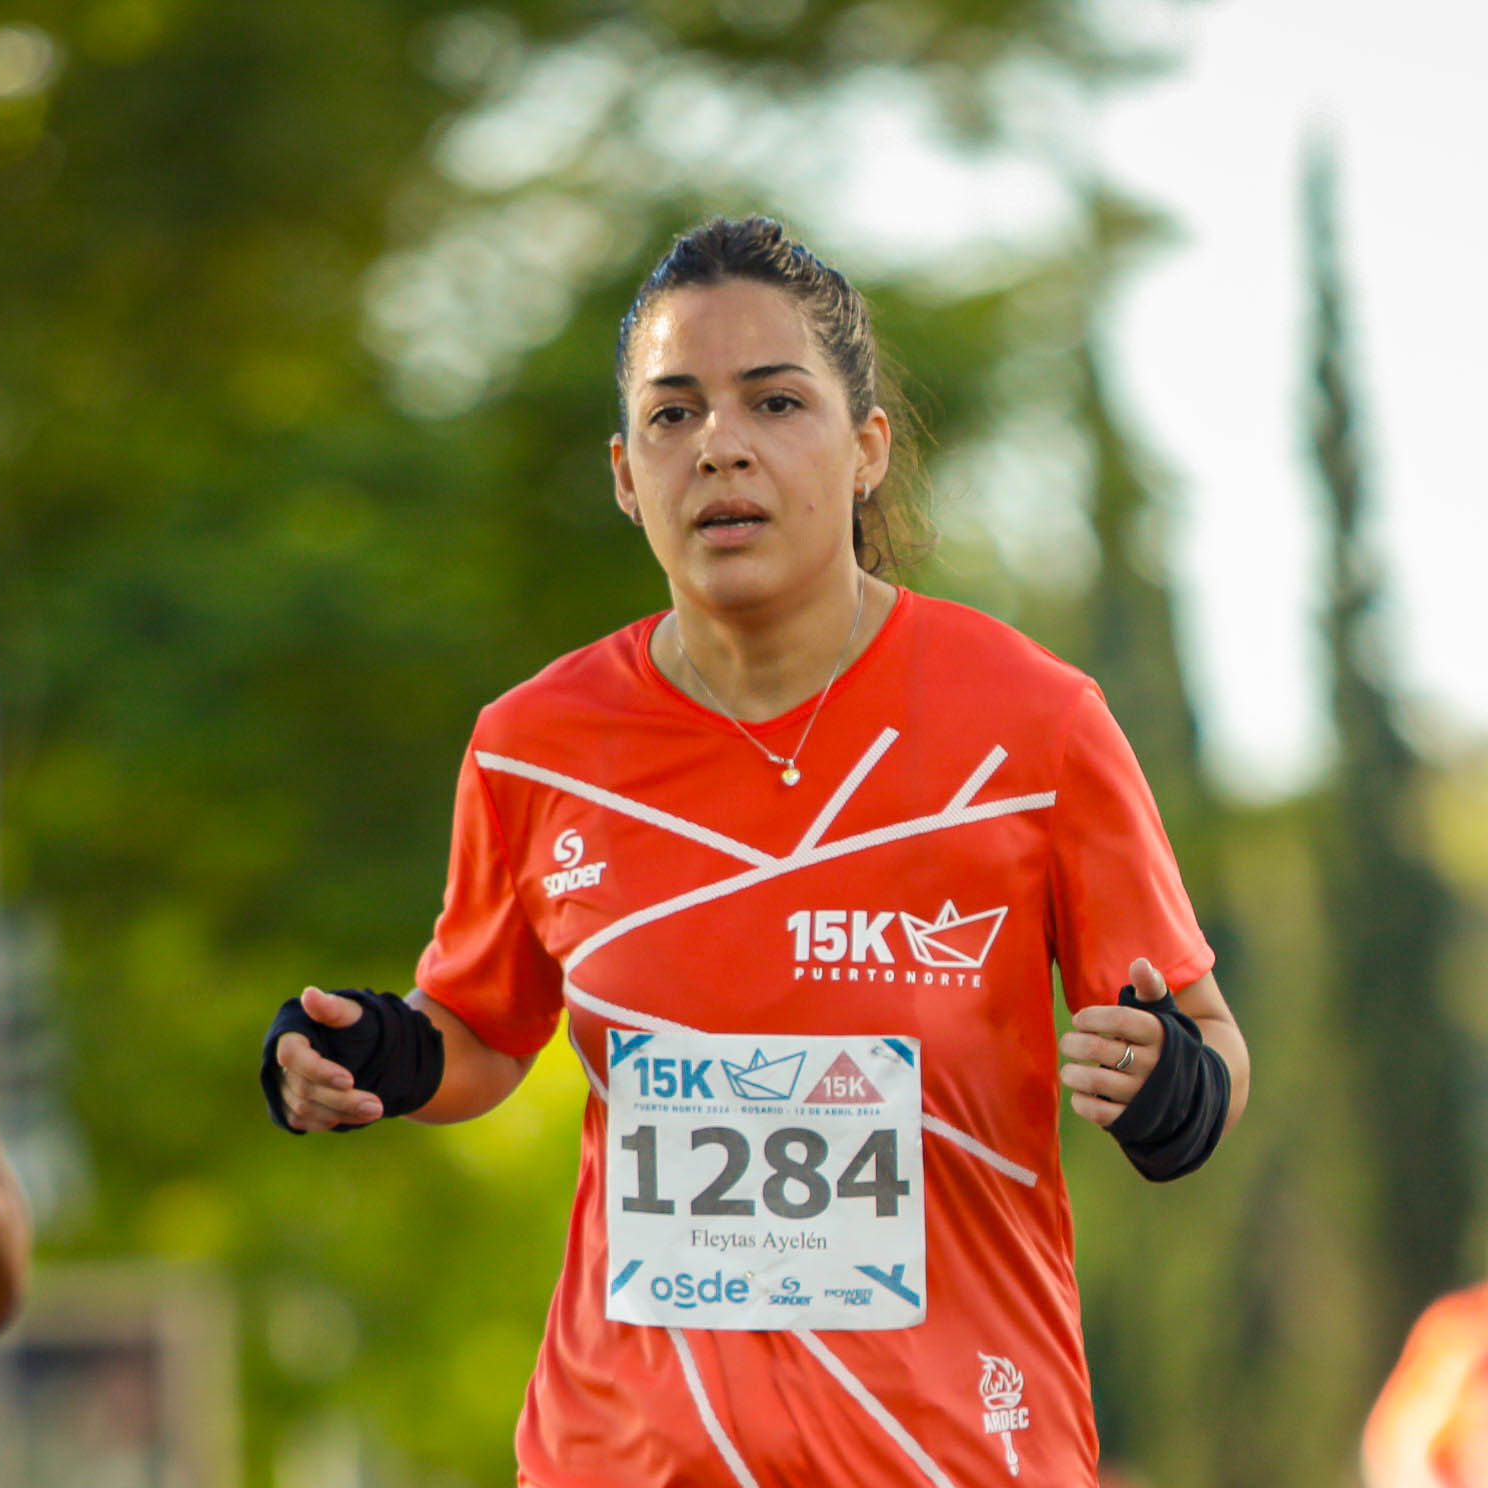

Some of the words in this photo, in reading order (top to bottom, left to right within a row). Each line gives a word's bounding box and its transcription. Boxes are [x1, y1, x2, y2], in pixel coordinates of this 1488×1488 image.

[786, 909, 896, 964] 15K
[794, 967, 895, 983] PUERTO
[905, 971, 981, 988] NORTE
[633, 1057, 715, 1099] 15K
[822, 1075, 867, 1098] 15K
[741, 1105, 784, 1115] ROSARIO
[621, 1124, 910, 1219] 1284
[690, 1229, 756, 1252] Fleytas
[762, 1230, 828, 1253] Ayelén
[650, 1269, 750, 1304] osde
[983, 1406, 1030, 1434] ARDEC
